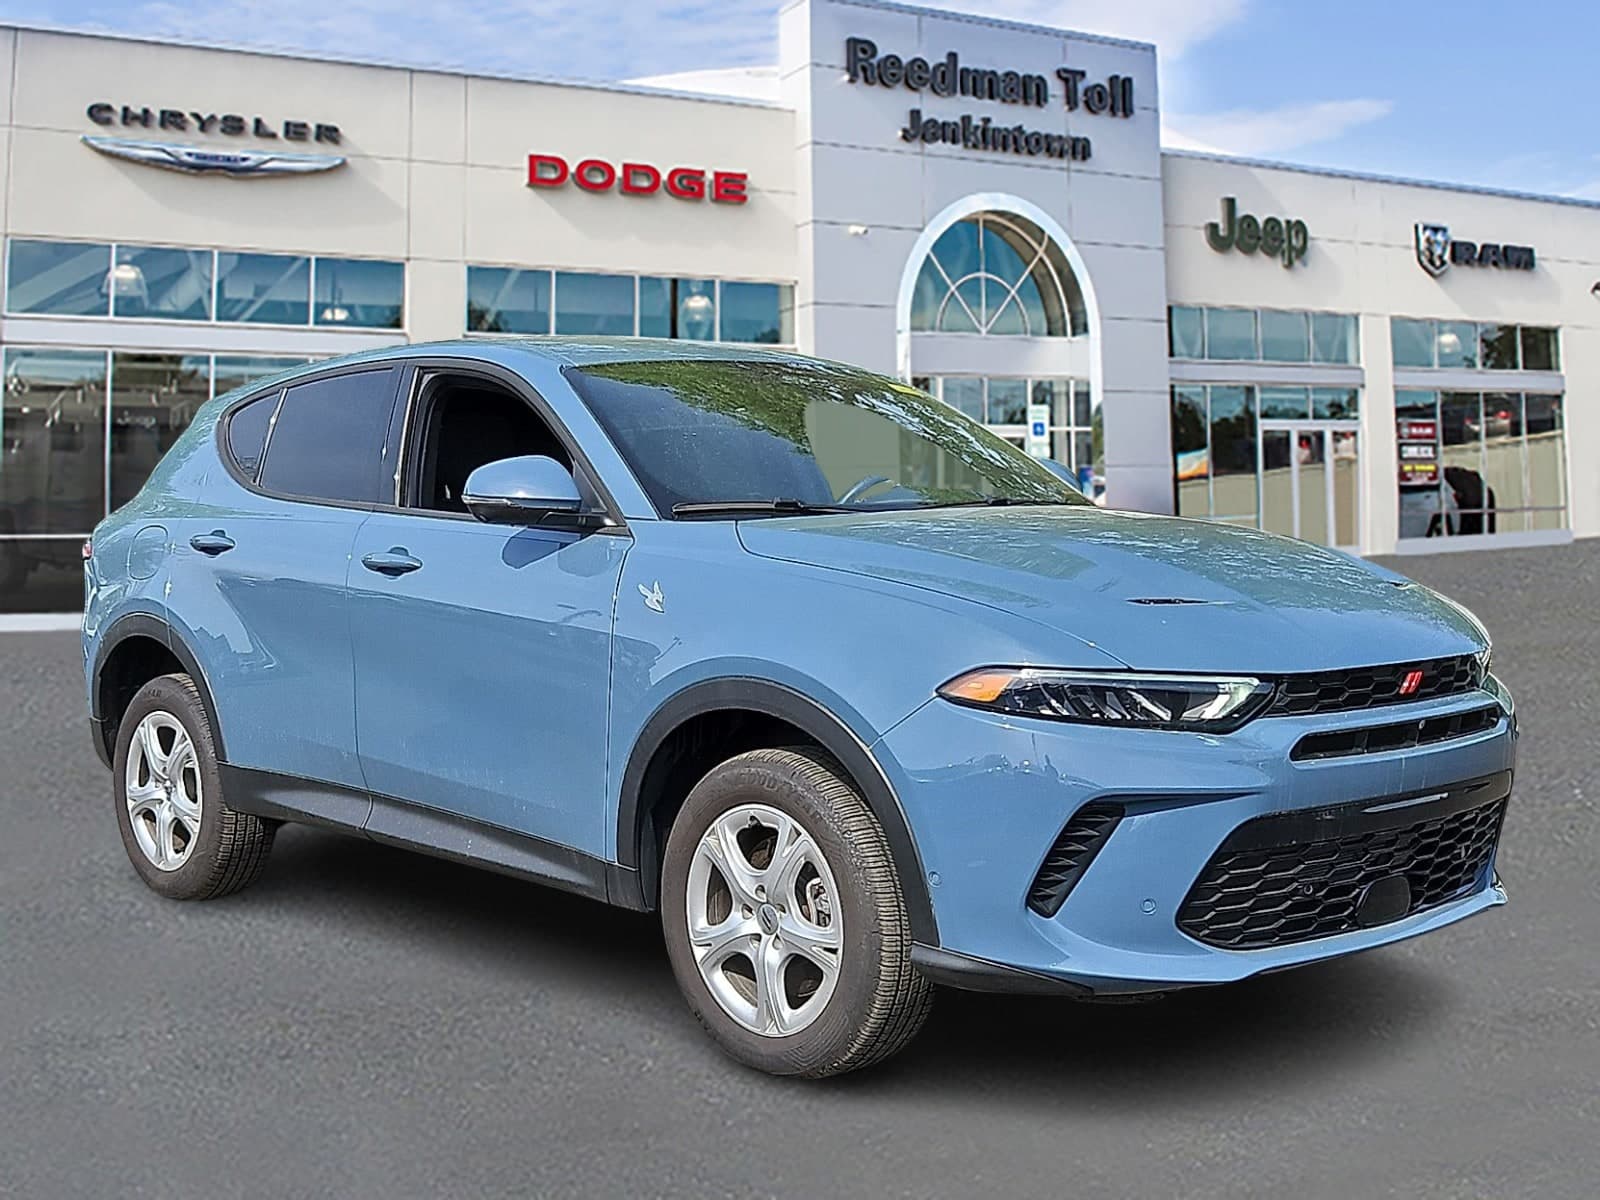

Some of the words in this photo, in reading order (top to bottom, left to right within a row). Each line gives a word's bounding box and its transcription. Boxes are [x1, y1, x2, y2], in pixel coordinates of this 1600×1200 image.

[845, 37, 1048, 107] Reedman
[1056, 67, 1134, 118] Toll
[87, 102, 342, 145] CHRYSLER
[901, 109, 1093, 161] Jenkintown
[527, 154, 748, 203] DODGE
[1205, 197, 1309, 270] Jeep
[1450, 240, 1536, 271] RAM
